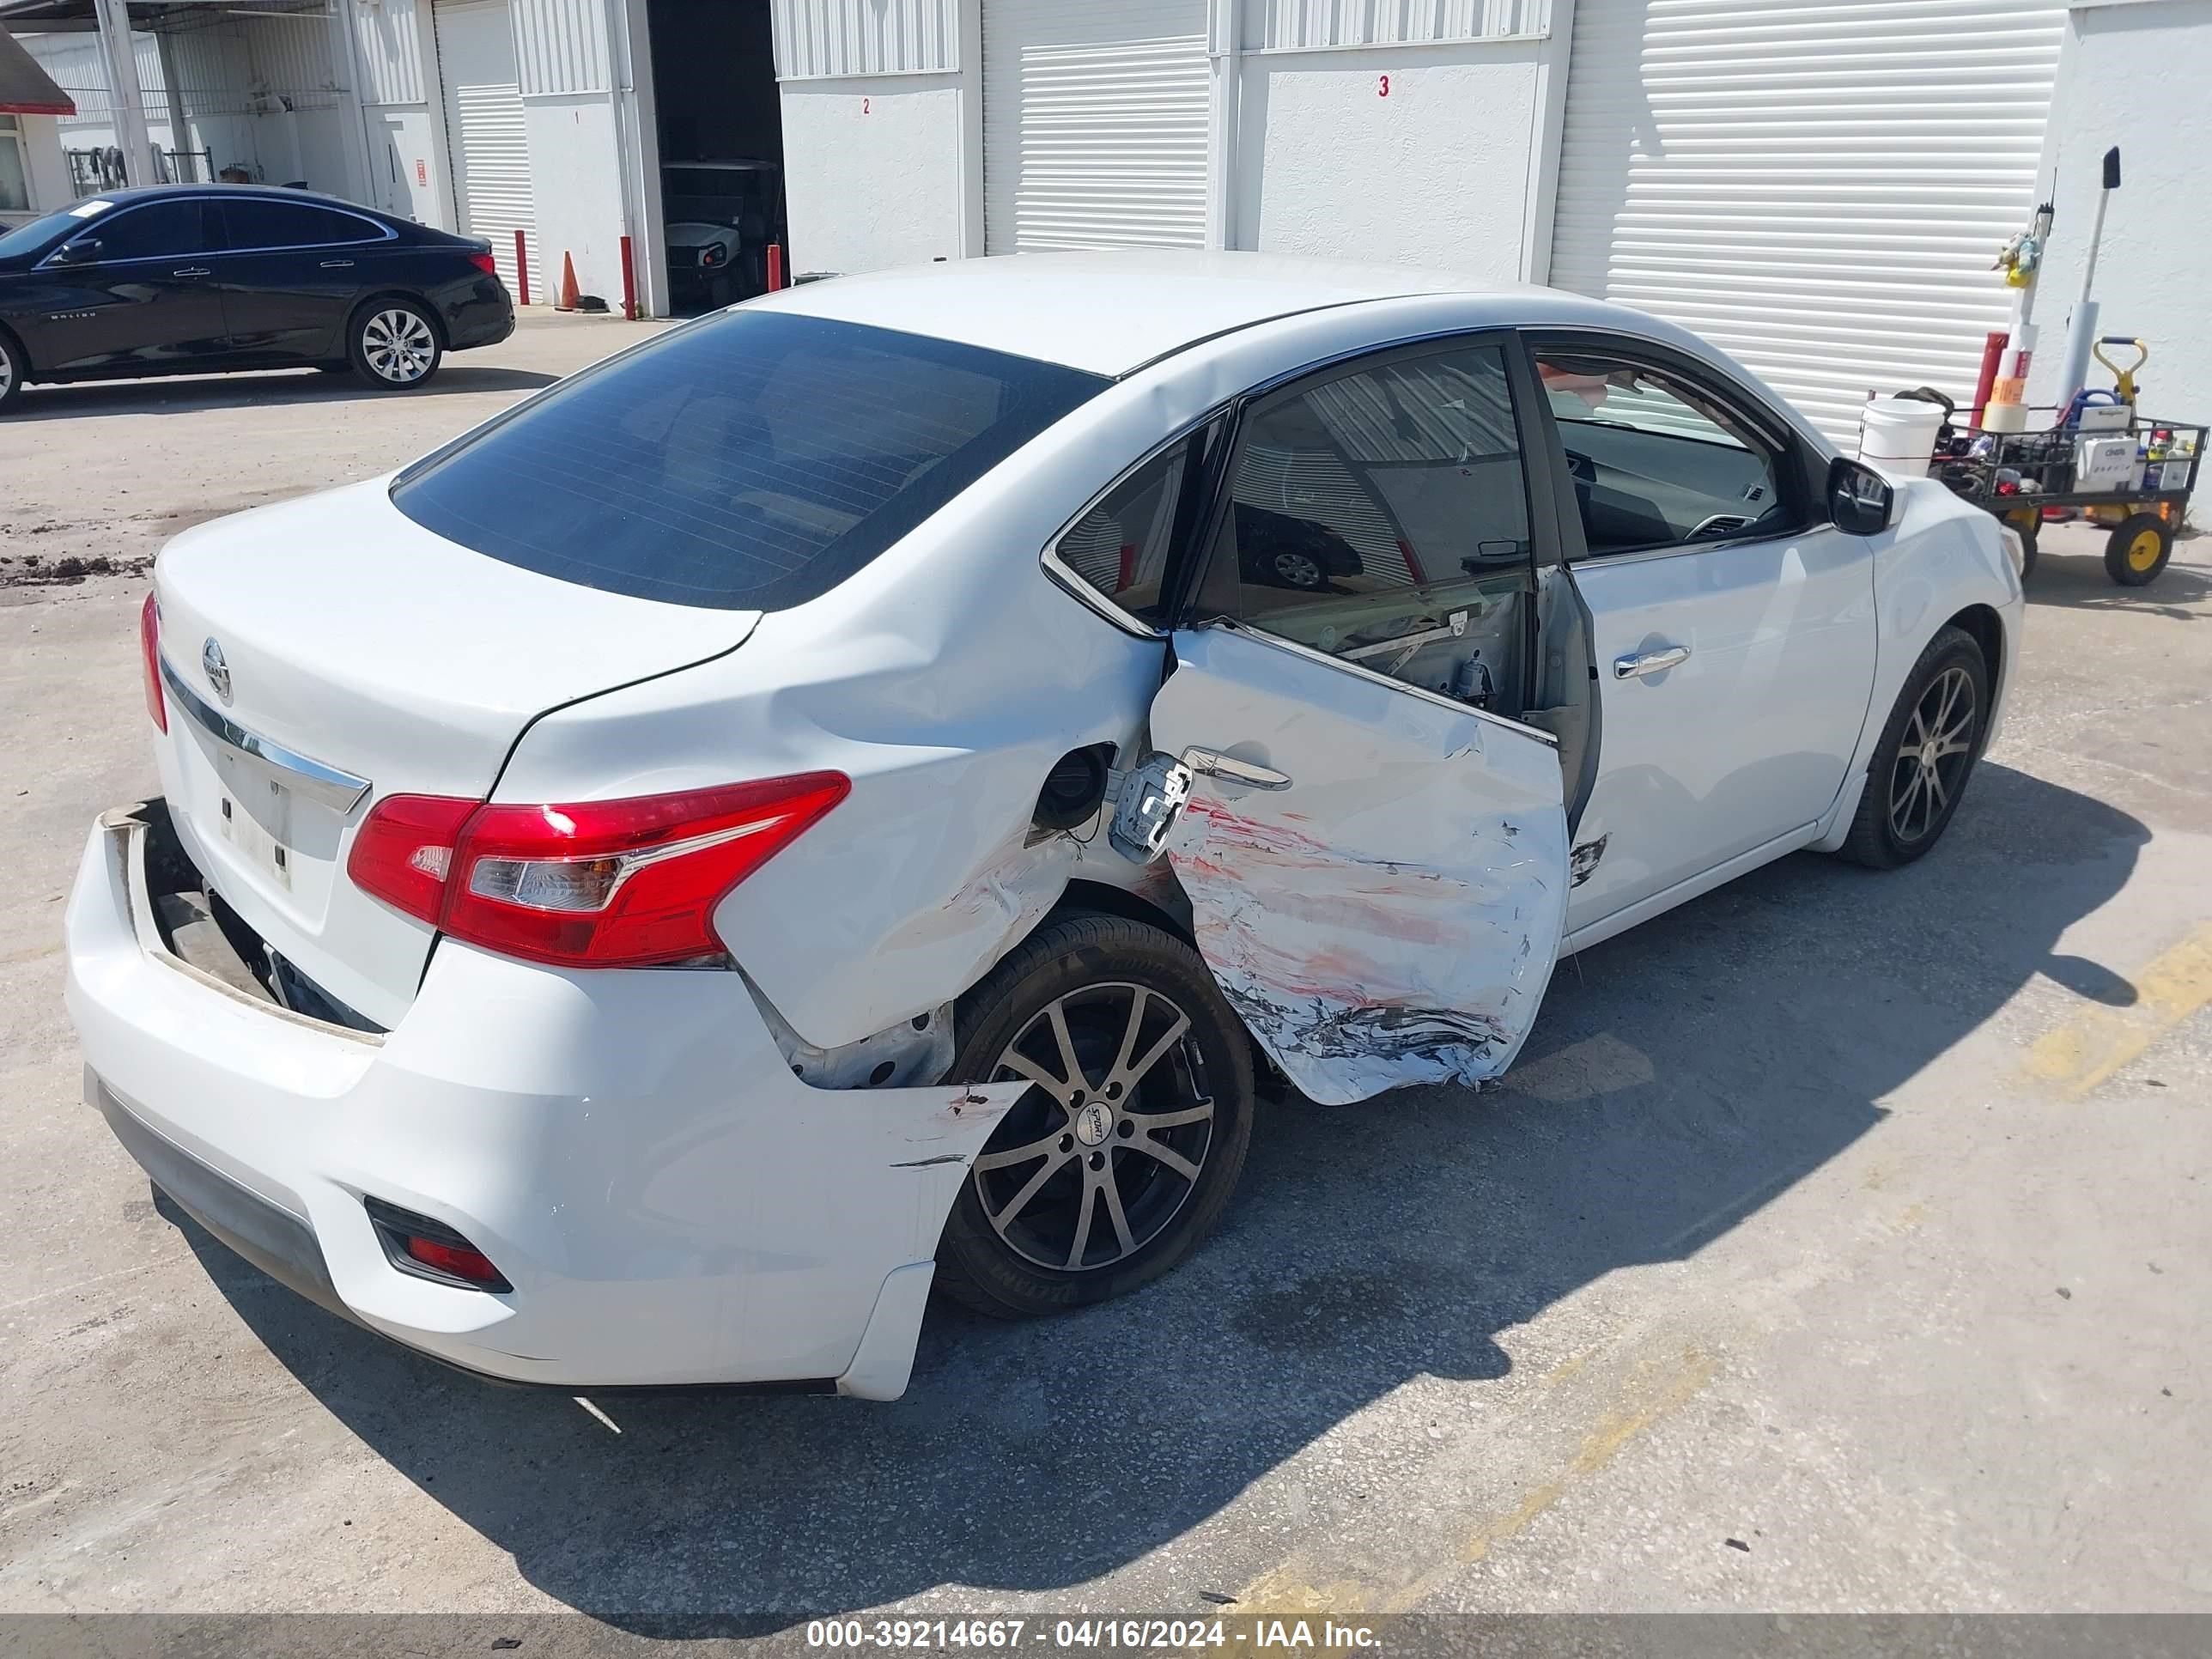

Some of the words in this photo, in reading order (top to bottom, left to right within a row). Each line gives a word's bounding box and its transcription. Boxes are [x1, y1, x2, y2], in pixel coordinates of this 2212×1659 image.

[1378, 75, 1389, 97] 3
[863, 98, 870, 114] 2
[1091, 1108, 1103, 1139] SPORT
